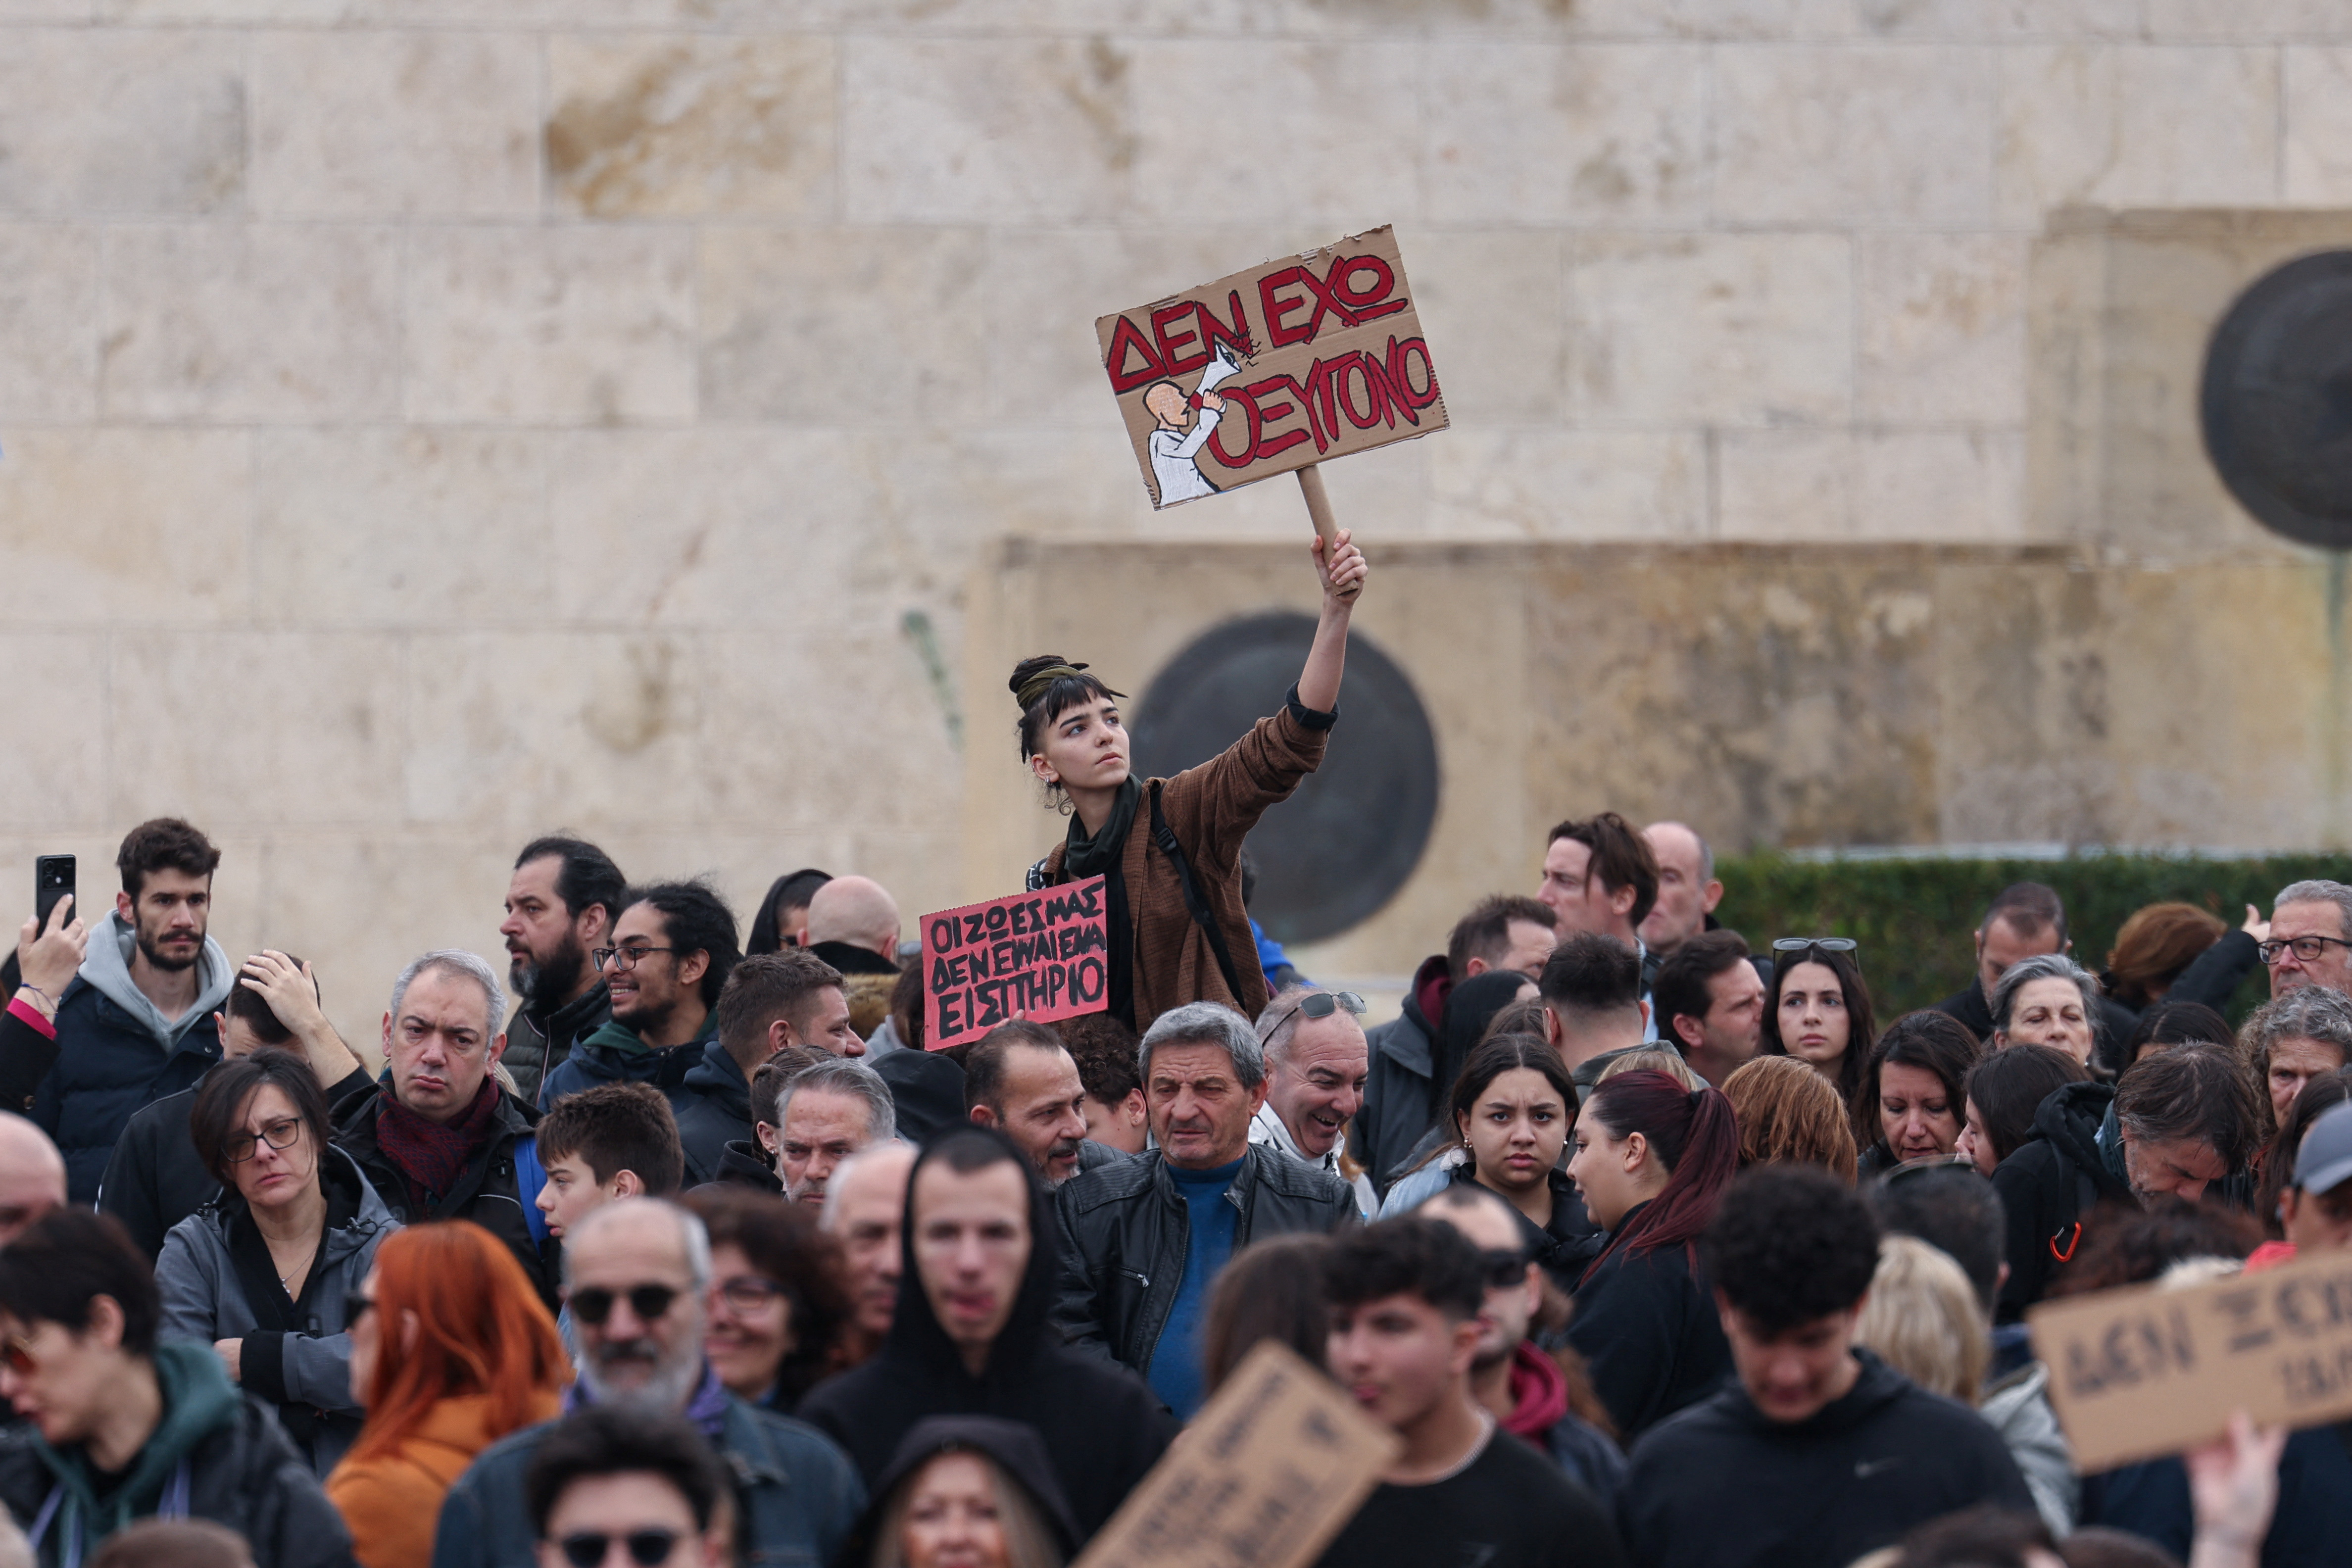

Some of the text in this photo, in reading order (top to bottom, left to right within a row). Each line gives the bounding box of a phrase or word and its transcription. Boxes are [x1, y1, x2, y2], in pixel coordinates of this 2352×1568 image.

[1106, 255, 1408, 395] ΔΕΝ ΕΧΩ
[1205, 335, 1438, 468] ΟΞΥΓΟΝΟ
[931, 880, 1105, 954] ΟΙ ΖΩΕΣ ΜΑΣ
[932, 946, 990, 994] ΔΕΝ
[1058, 922, 1107, 961] ΕΝΑ
[938, 957, 1105, 1039] ΕΙΣΙΤΗΡΙΟ
